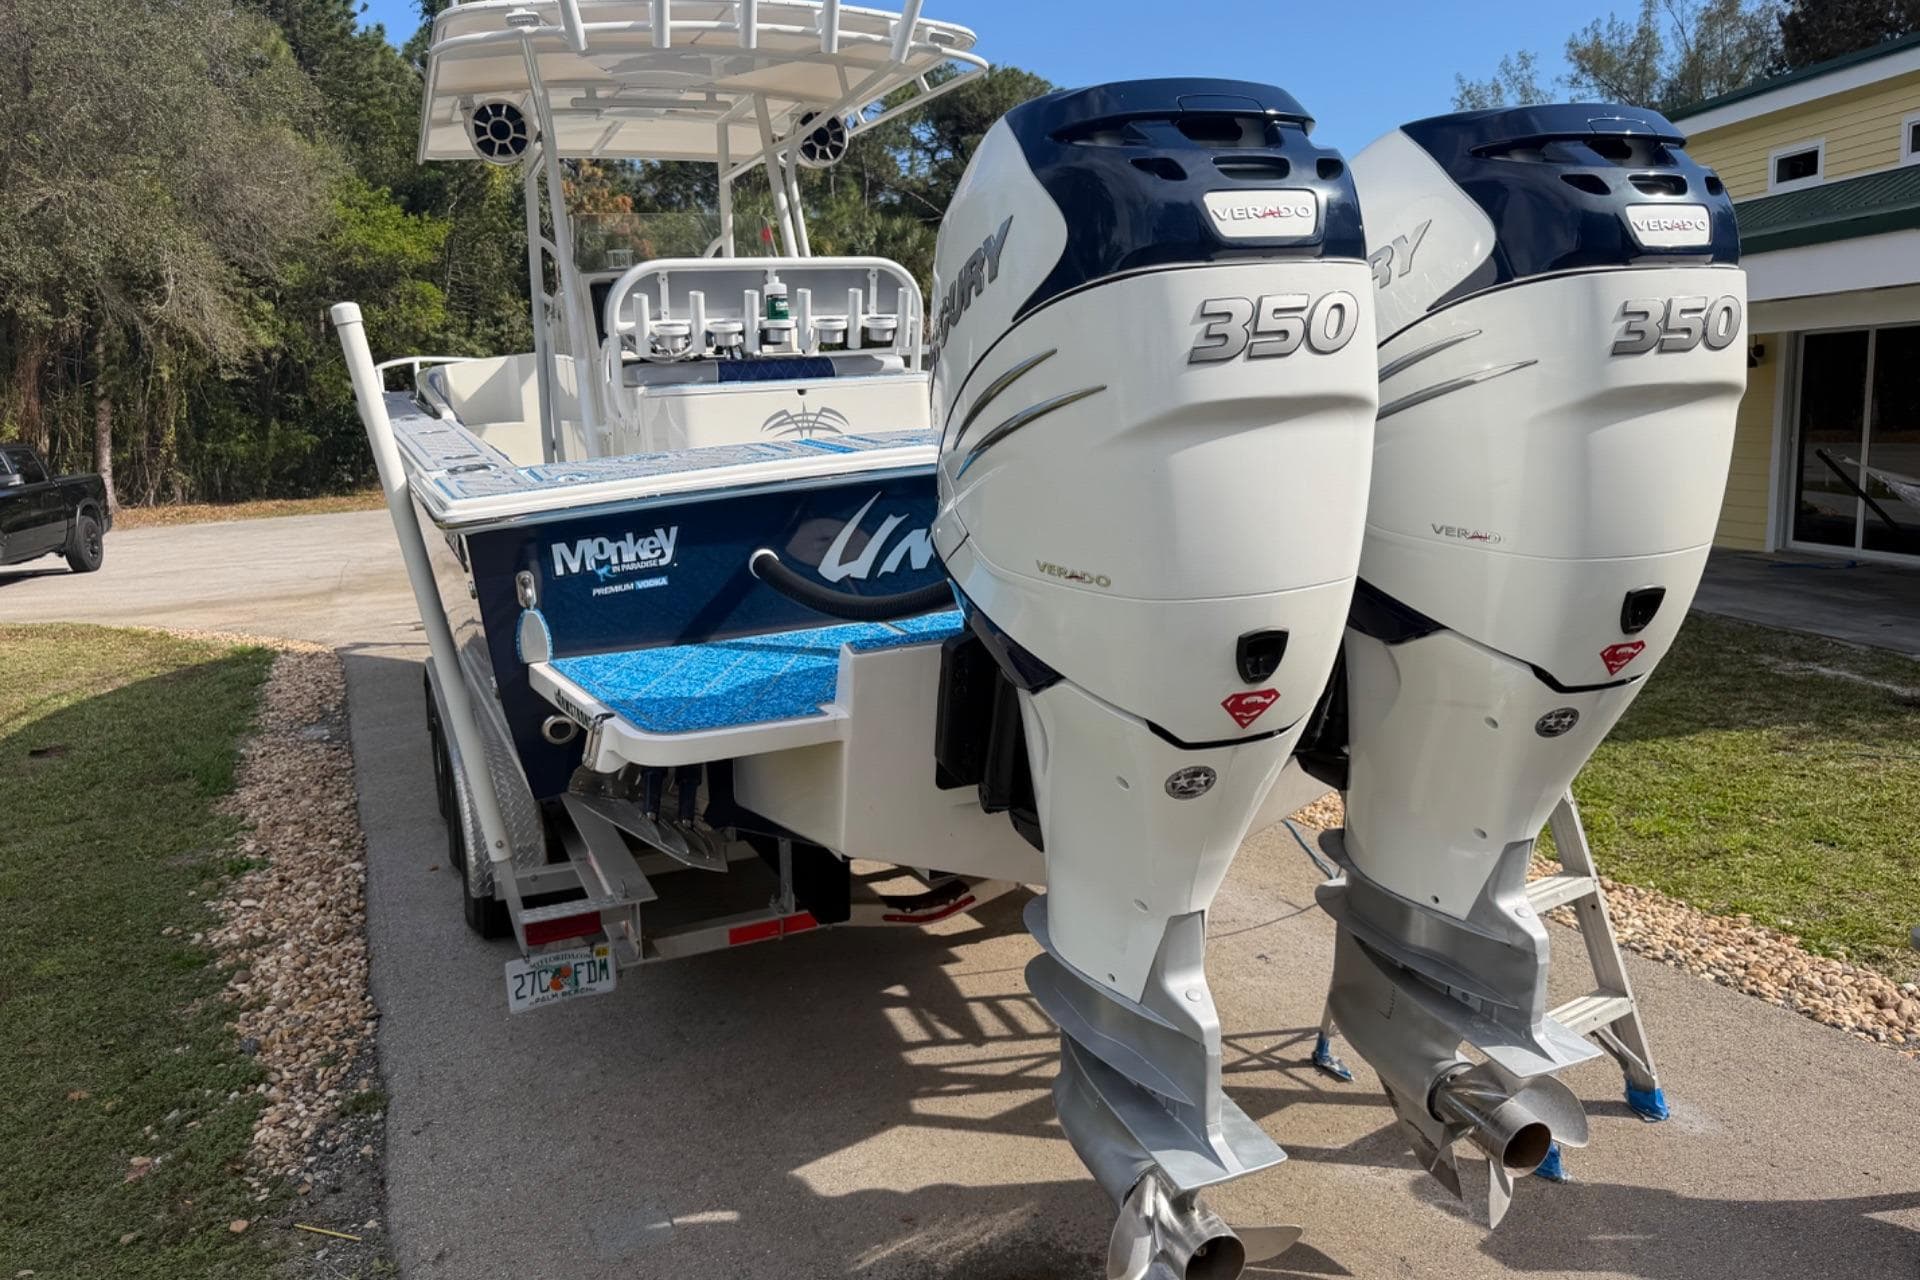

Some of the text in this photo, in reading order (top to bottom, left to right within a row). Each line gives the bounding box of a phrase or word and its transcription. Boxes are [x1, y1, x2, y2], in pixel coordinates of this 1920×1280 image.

[1211, 204, 1313, 222] VERADO
[1632, 217, 1707, 232] VERADO
[1187, 290, 1359, 366] 350
[1609, 294, 1742, 357] 350
[551, 526, 679, 577] Monkey
[611, 558, 659, 574] IN PARADISE
[1035, 559, 1112, 588] VERADO
[592, 576, 668, 597] PREMIUM VODKA
[512, 957, 610, 1001] 27C FDM
[534, 985, 593, 1005] PALM BEACH
